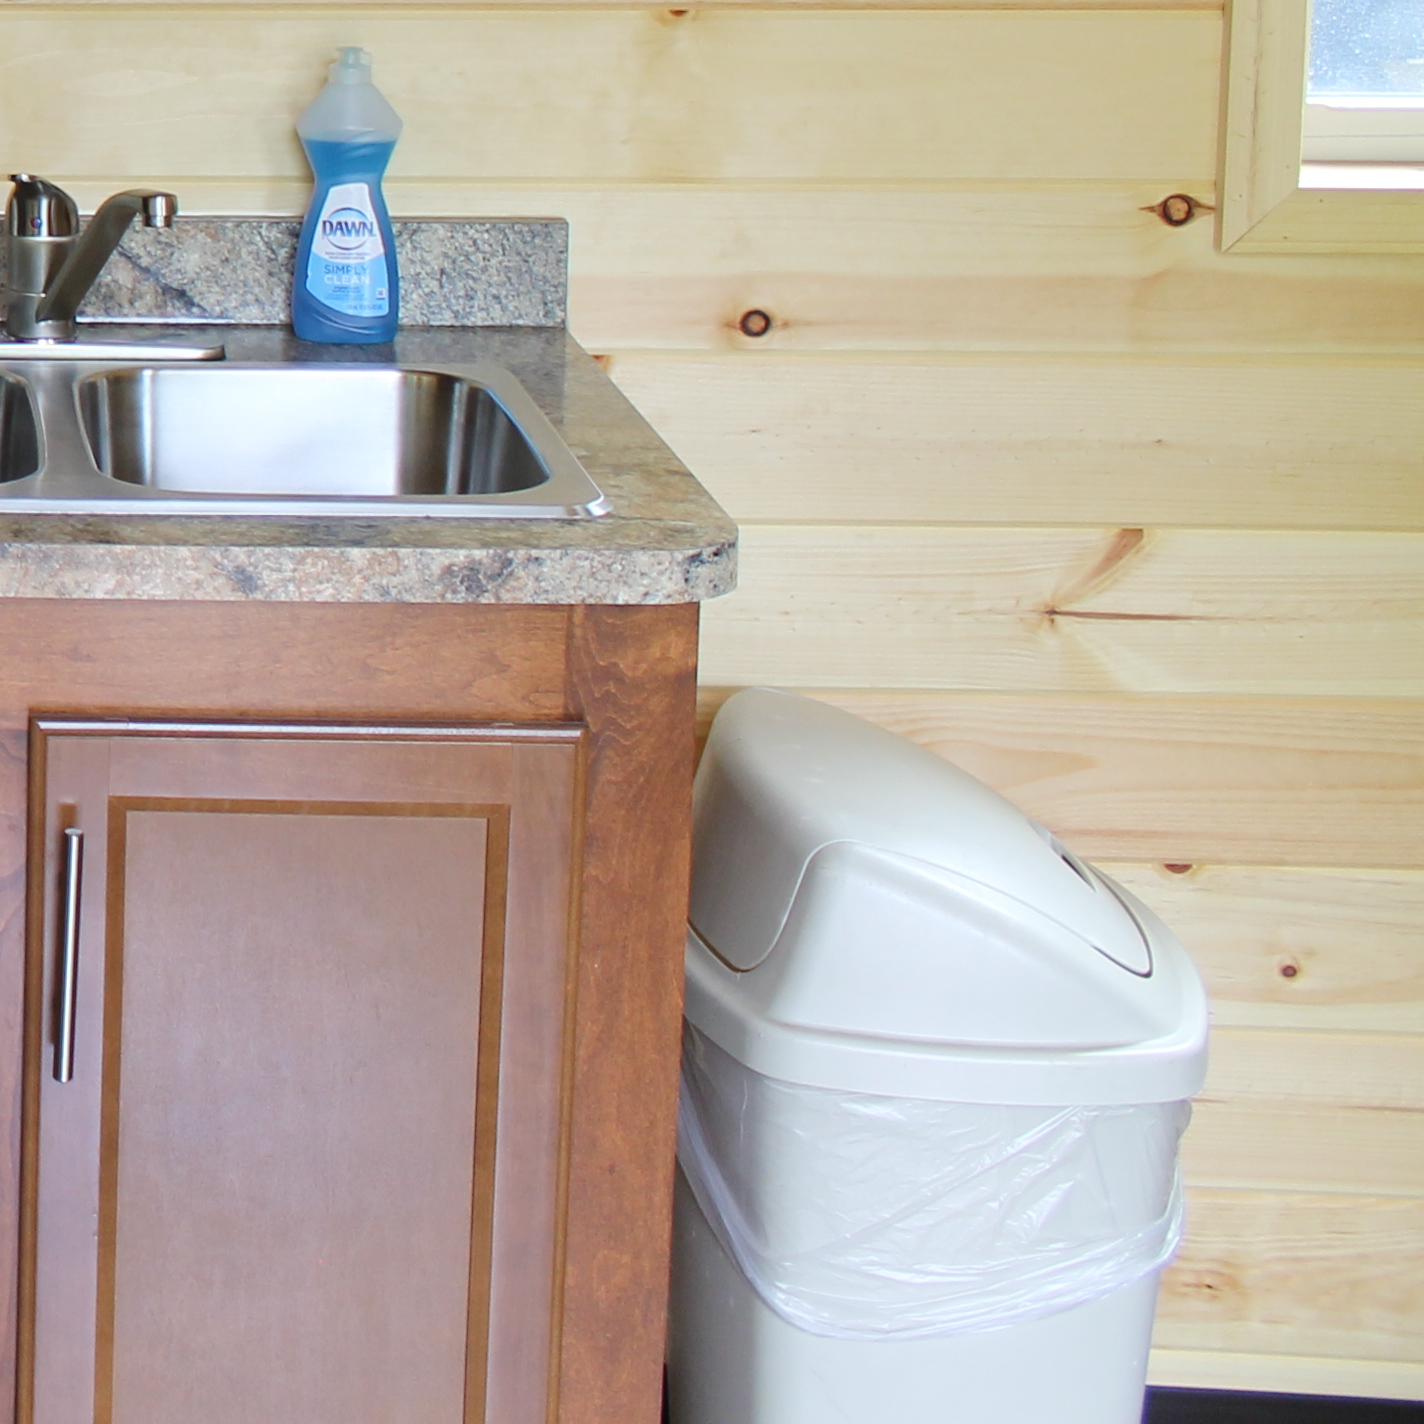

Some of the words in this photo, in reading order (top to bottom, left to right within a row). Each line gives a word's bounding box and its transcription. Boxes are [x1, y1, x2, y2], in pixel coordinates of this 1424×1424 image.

[321, 220, 376, 237] DAWN
[324, 264, 368, 274] SIMPLY
[324, 275, 370, 285] CLEAN
